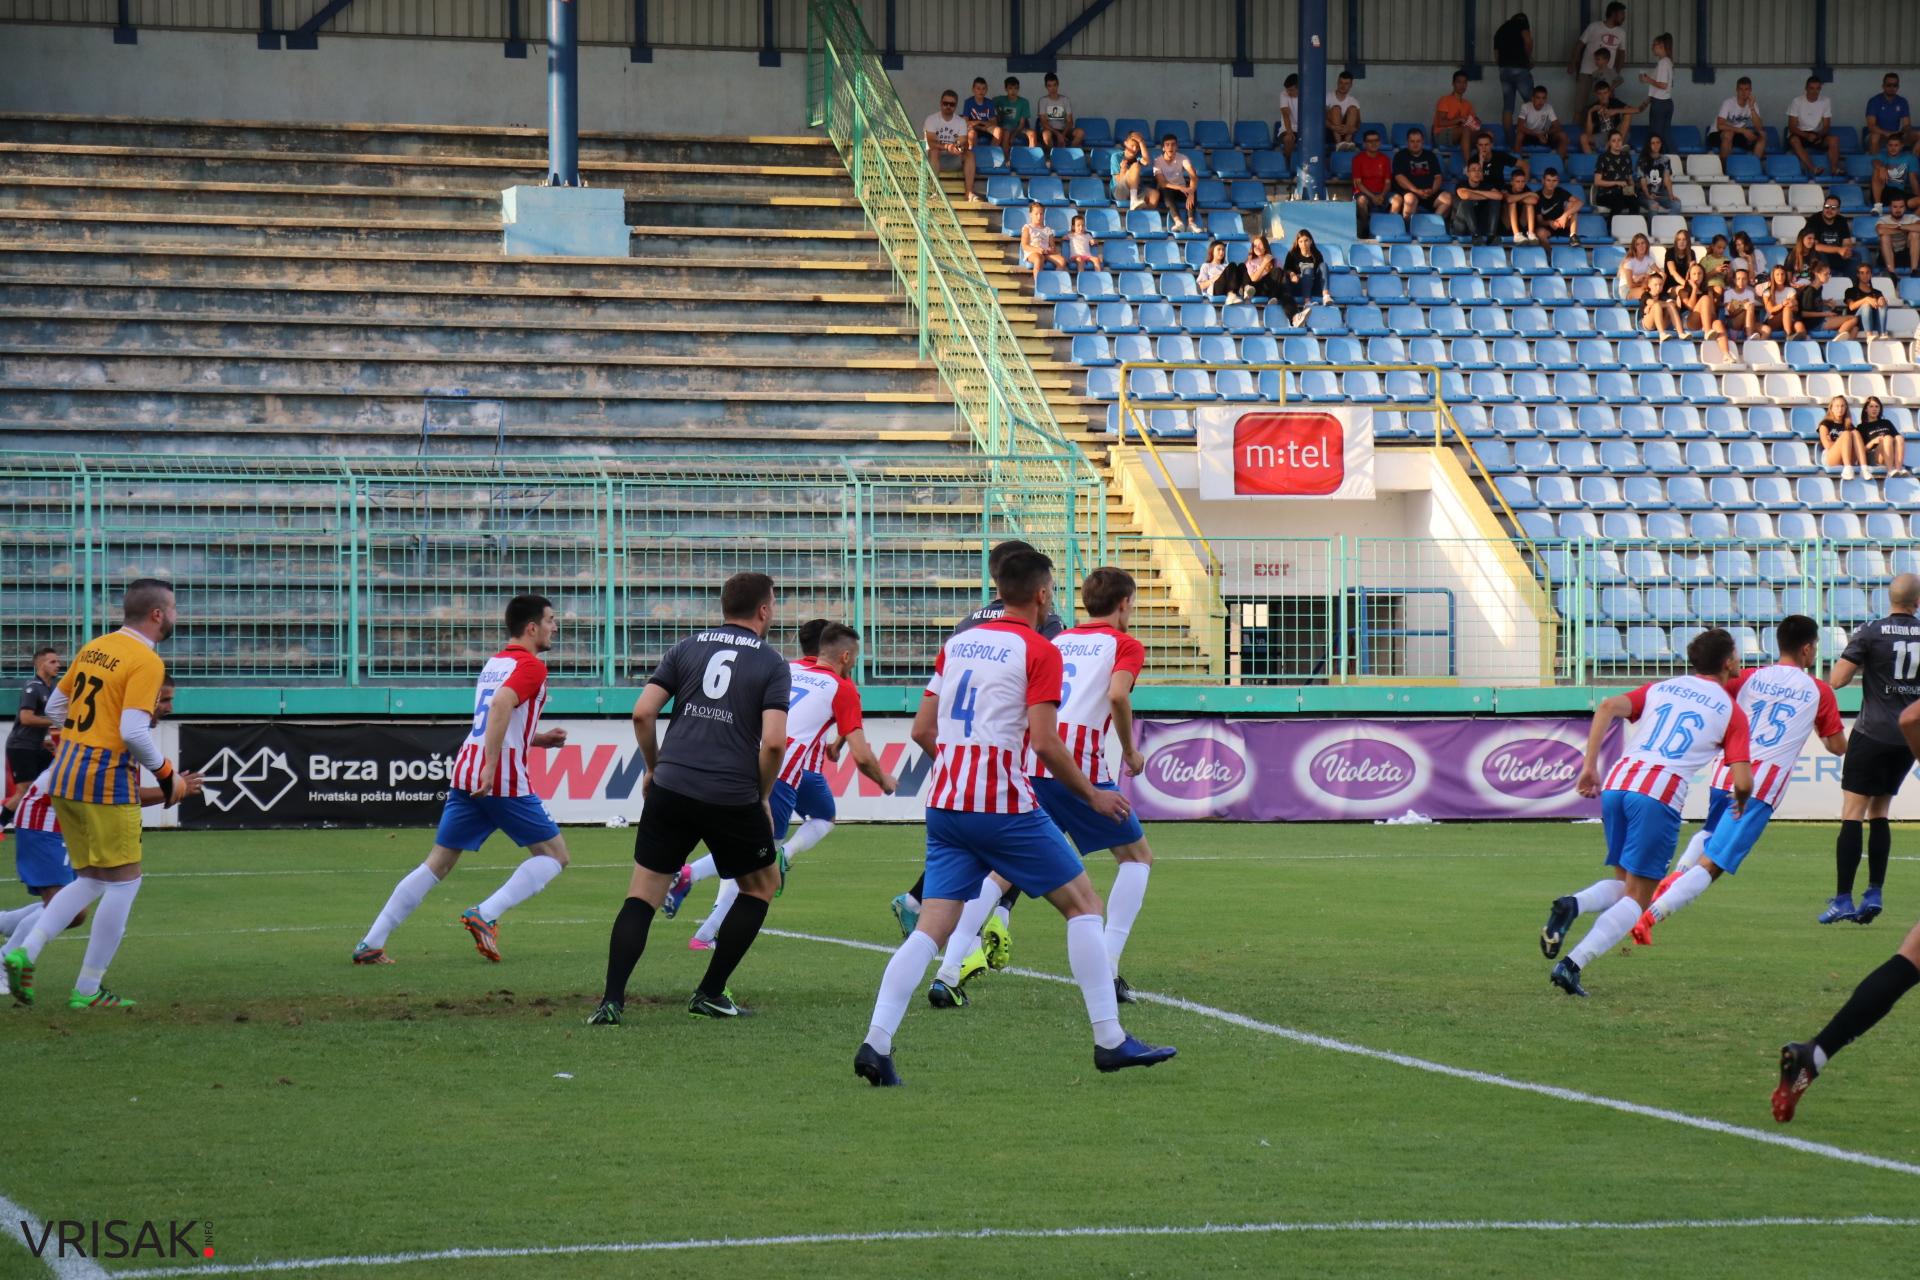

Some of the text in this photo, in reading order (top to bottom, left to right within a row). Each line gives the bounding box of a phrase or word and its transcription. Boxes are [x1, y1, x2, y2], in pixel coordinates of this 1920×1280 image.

[1246, 437, 1331, 468] m:tel
[1253, 563, 1290, 577] EXIT
[697, 633, 761, 649] MZ LIJEVA OBALA
[1057, 642, 1103, 656] EŠPOLJE
[703, 650, 738, 699] 6
[1892, 641, 1920, 679] 11
[64, 671, 103, 732] 23
[472, 688, 495, 737] 5
[951, 669, 977, 738] 4
[1658, 684, 1728, 716] KNEŠPOLJE
[1640, 703, 1704, 760] 16
[1750, 700, 1796, 747] 15
[309, 752, 455, 787] Brza pošt
[1157, 753, 1232, 783] Violeta
[1322, 753, 1403, 783] Violeta
[1494, 753, 1576, 782] Violeta
[308, 791, 358, 802] Hrvatska
[360, 790, 392, 803] pošta
[395, 791, 434, 801] Mostar
